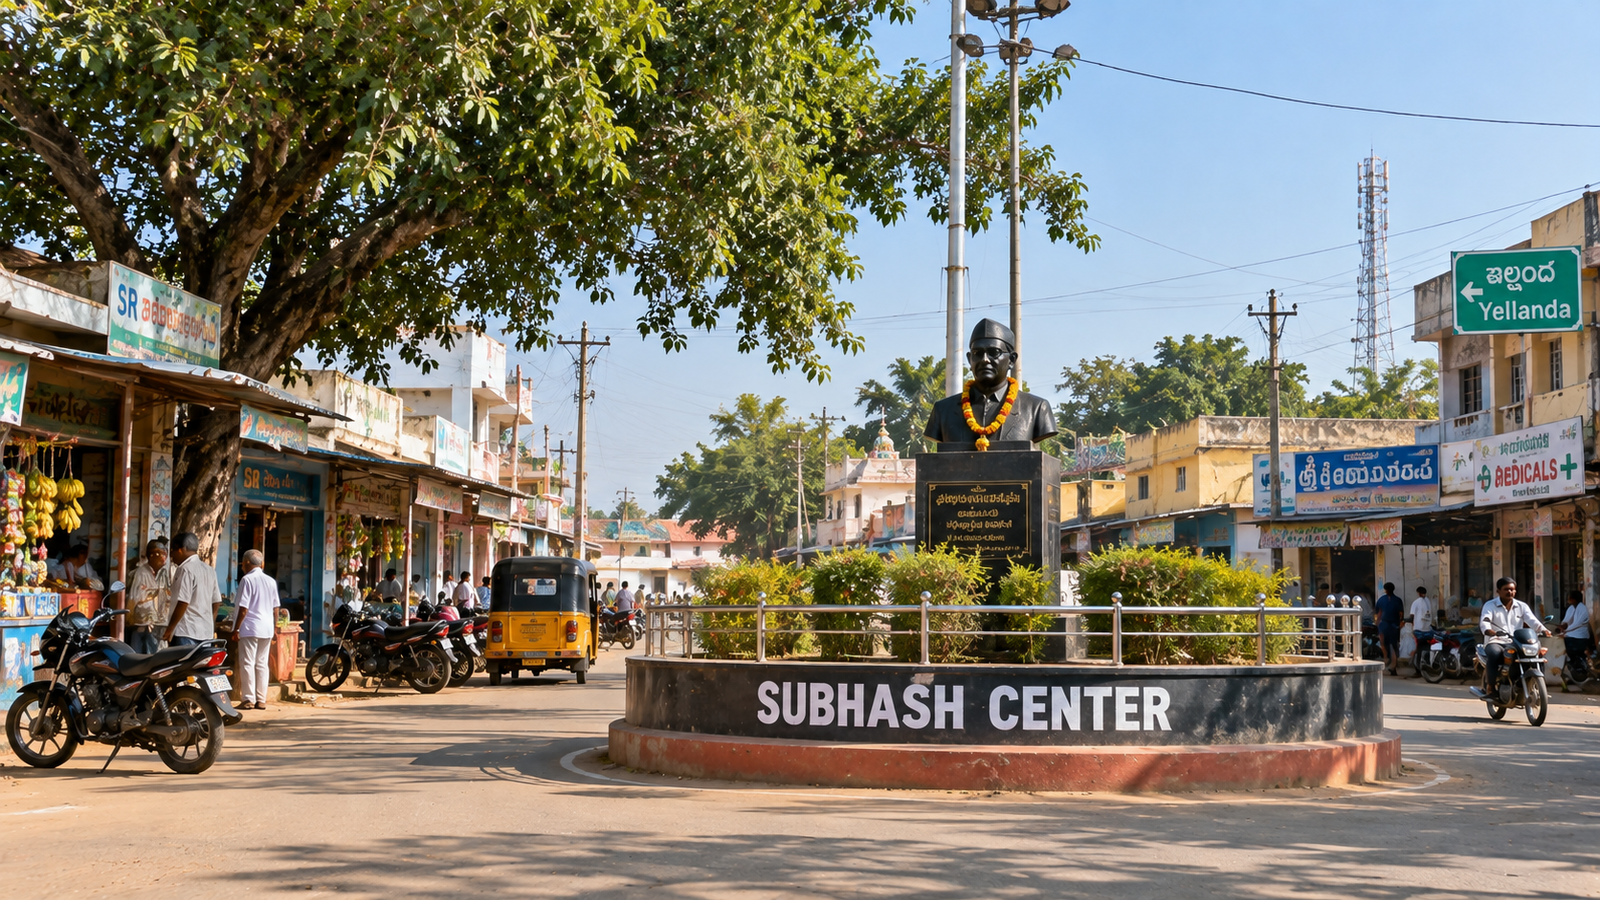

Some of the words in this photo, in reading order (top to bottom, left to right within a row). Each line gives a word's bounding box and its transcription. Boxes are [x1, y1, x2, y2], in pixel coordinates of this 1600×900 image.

[117, 283, 138, 321] SR
[1478, 299, 1571, 321] Yellanda
[243, 467, 260, 490] SR
[756, 680, 964, 730] SUBHASH
[988, 684, 1172, 731] CENTER
